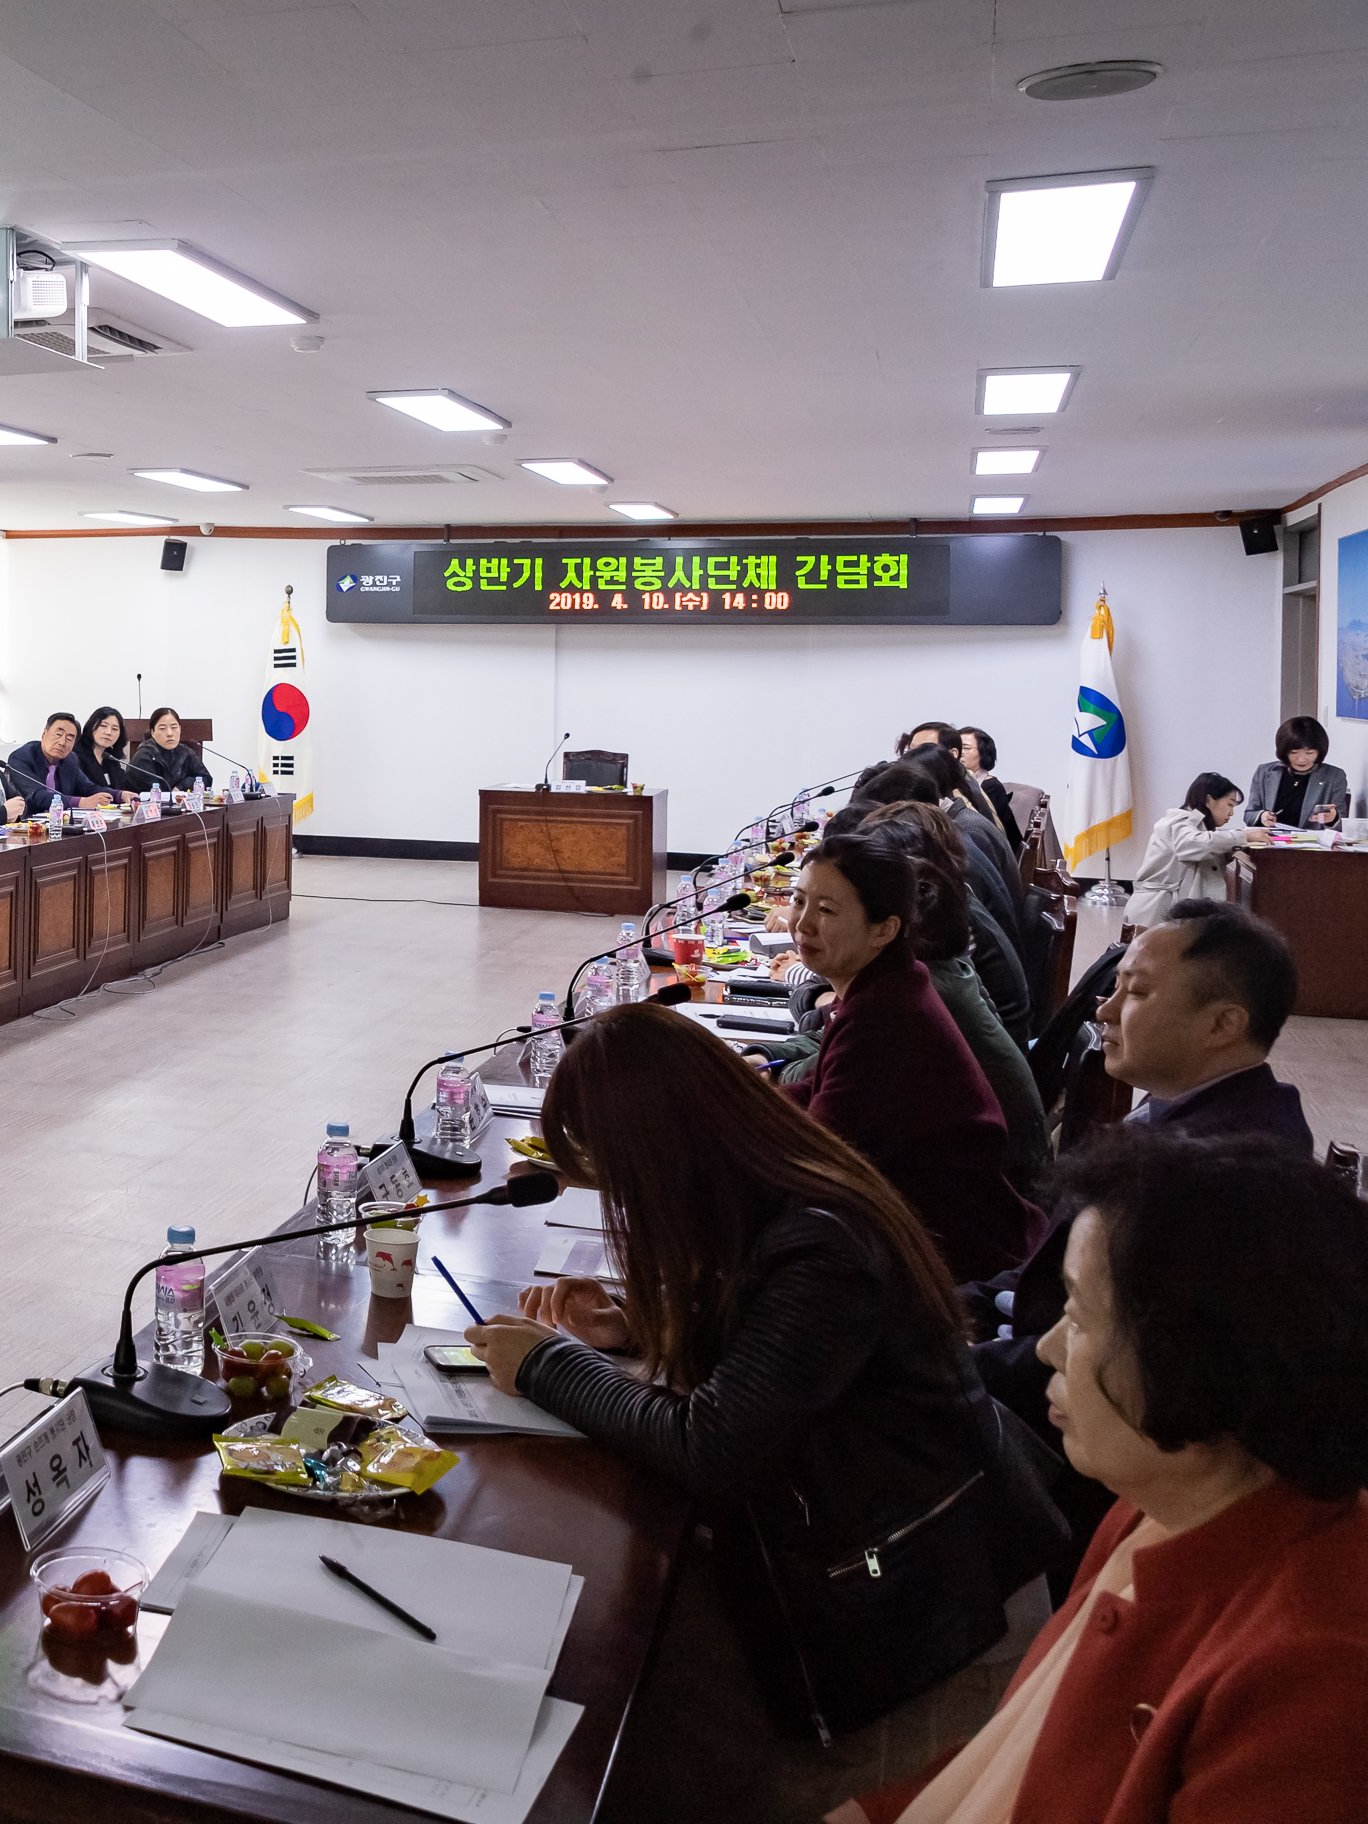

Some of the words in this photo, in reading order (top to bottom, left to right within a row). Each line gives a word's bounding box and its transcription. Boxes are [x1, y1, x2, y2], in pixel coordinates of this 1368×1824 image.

[360, 575, 401, 586] 광진구
[443, 556, 543, 592] 상반기
[559, 555, 777, 591] 자원봉사단체
[795, 553, 908, 590] 간담회
[549, 592, 599, 610] 2019.
[611, 592, 628, 610] 4.
[24, 1430, 95, 1517] 성옥자
